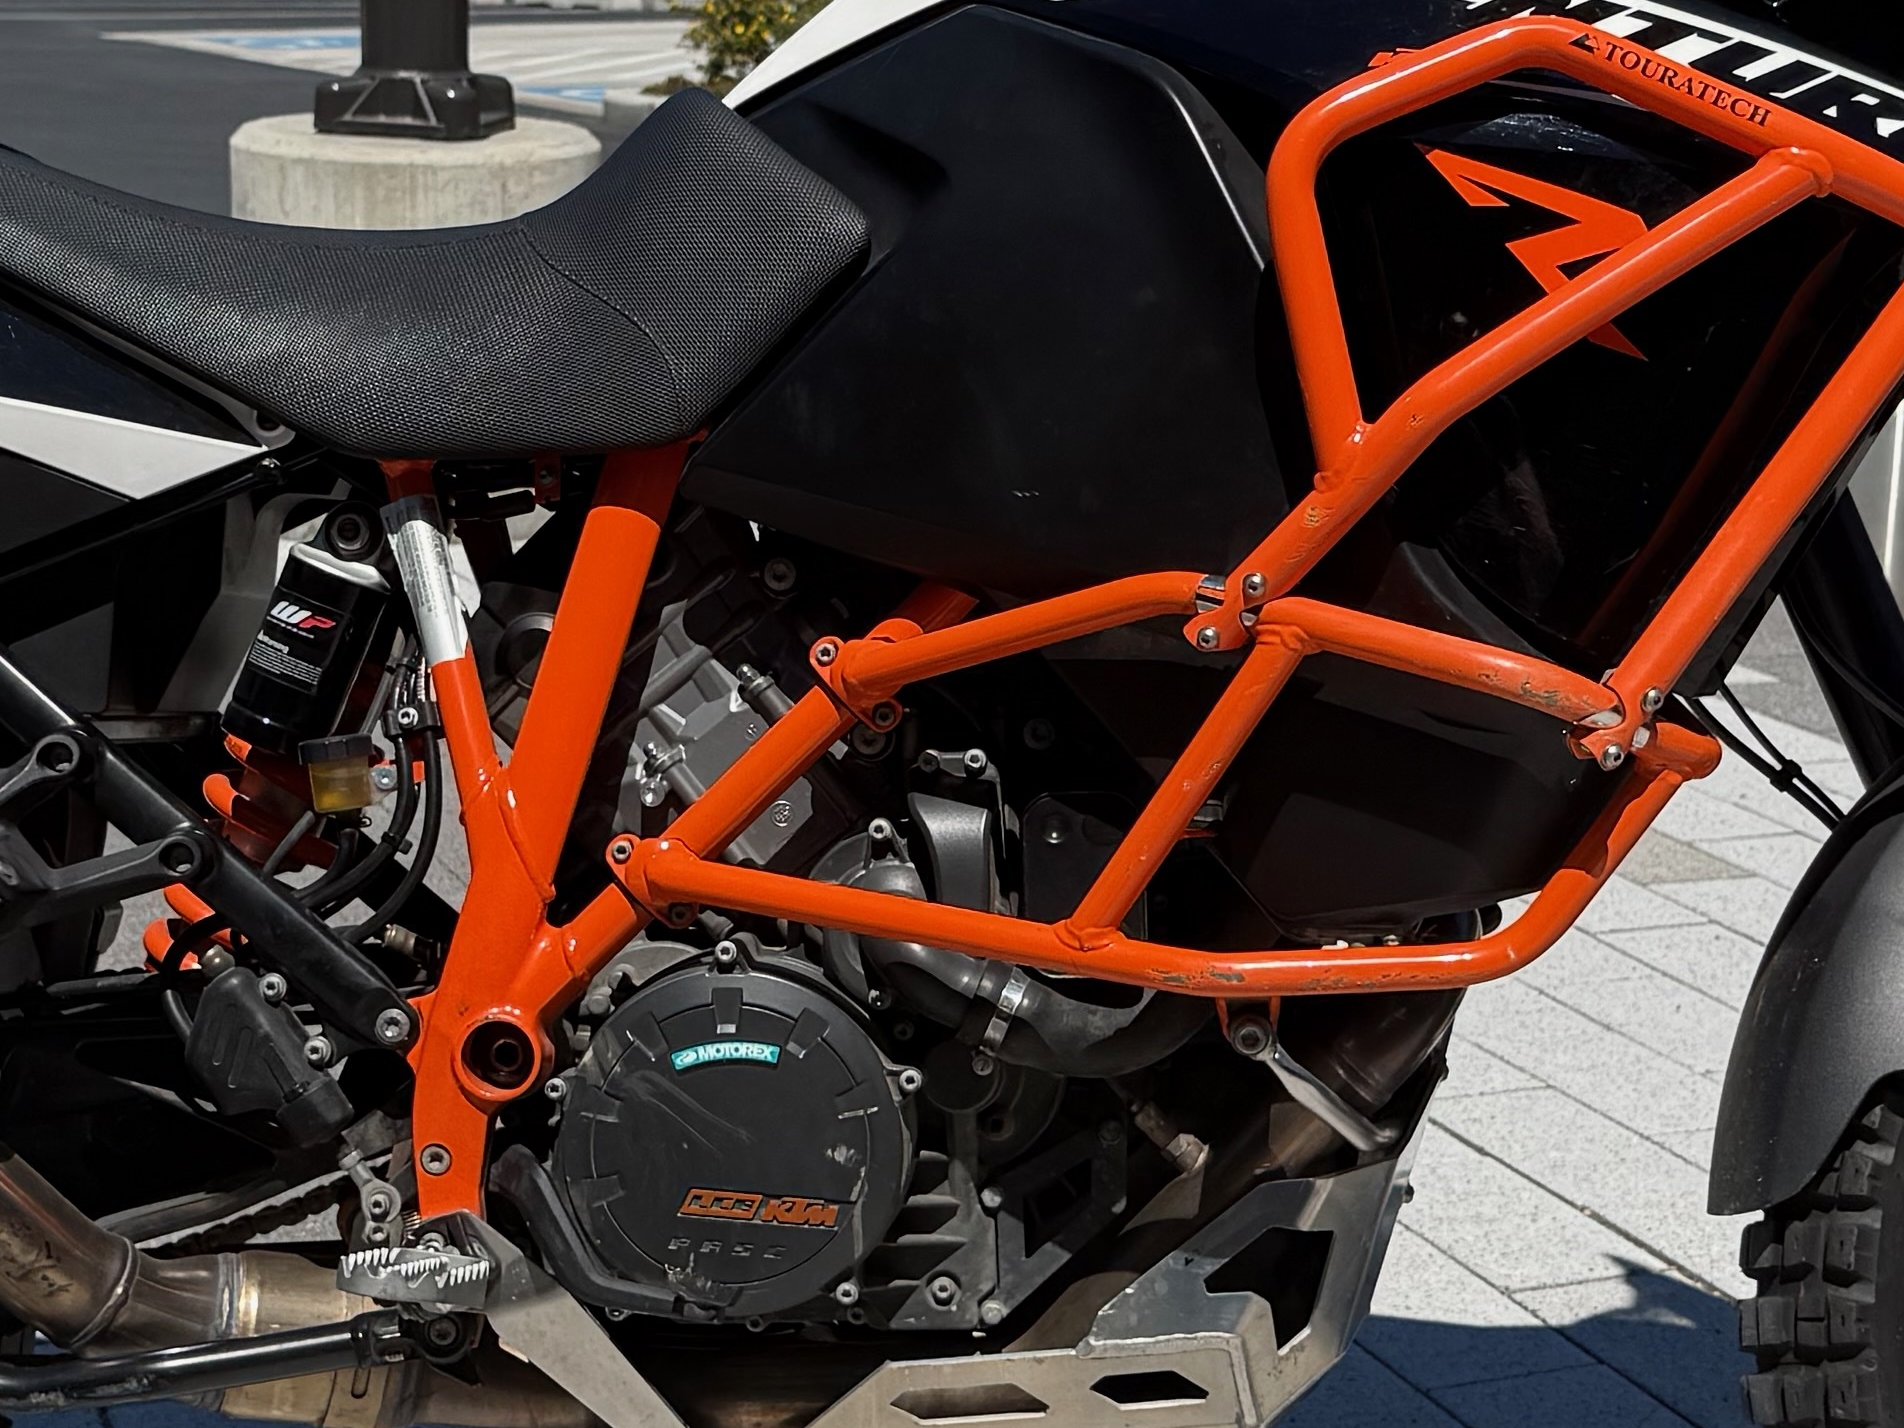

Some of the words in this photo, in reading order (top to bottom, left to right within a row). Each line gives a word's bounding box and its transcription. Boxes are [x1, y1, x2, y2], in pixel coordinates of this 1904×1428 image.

[1604, 41, 1772, 127] TOURATECH
[270, 600, 337, 632] WP
[696, 1041, 773, 1063] MOTOREX
[760, 1197, 840, 1227] KTM
